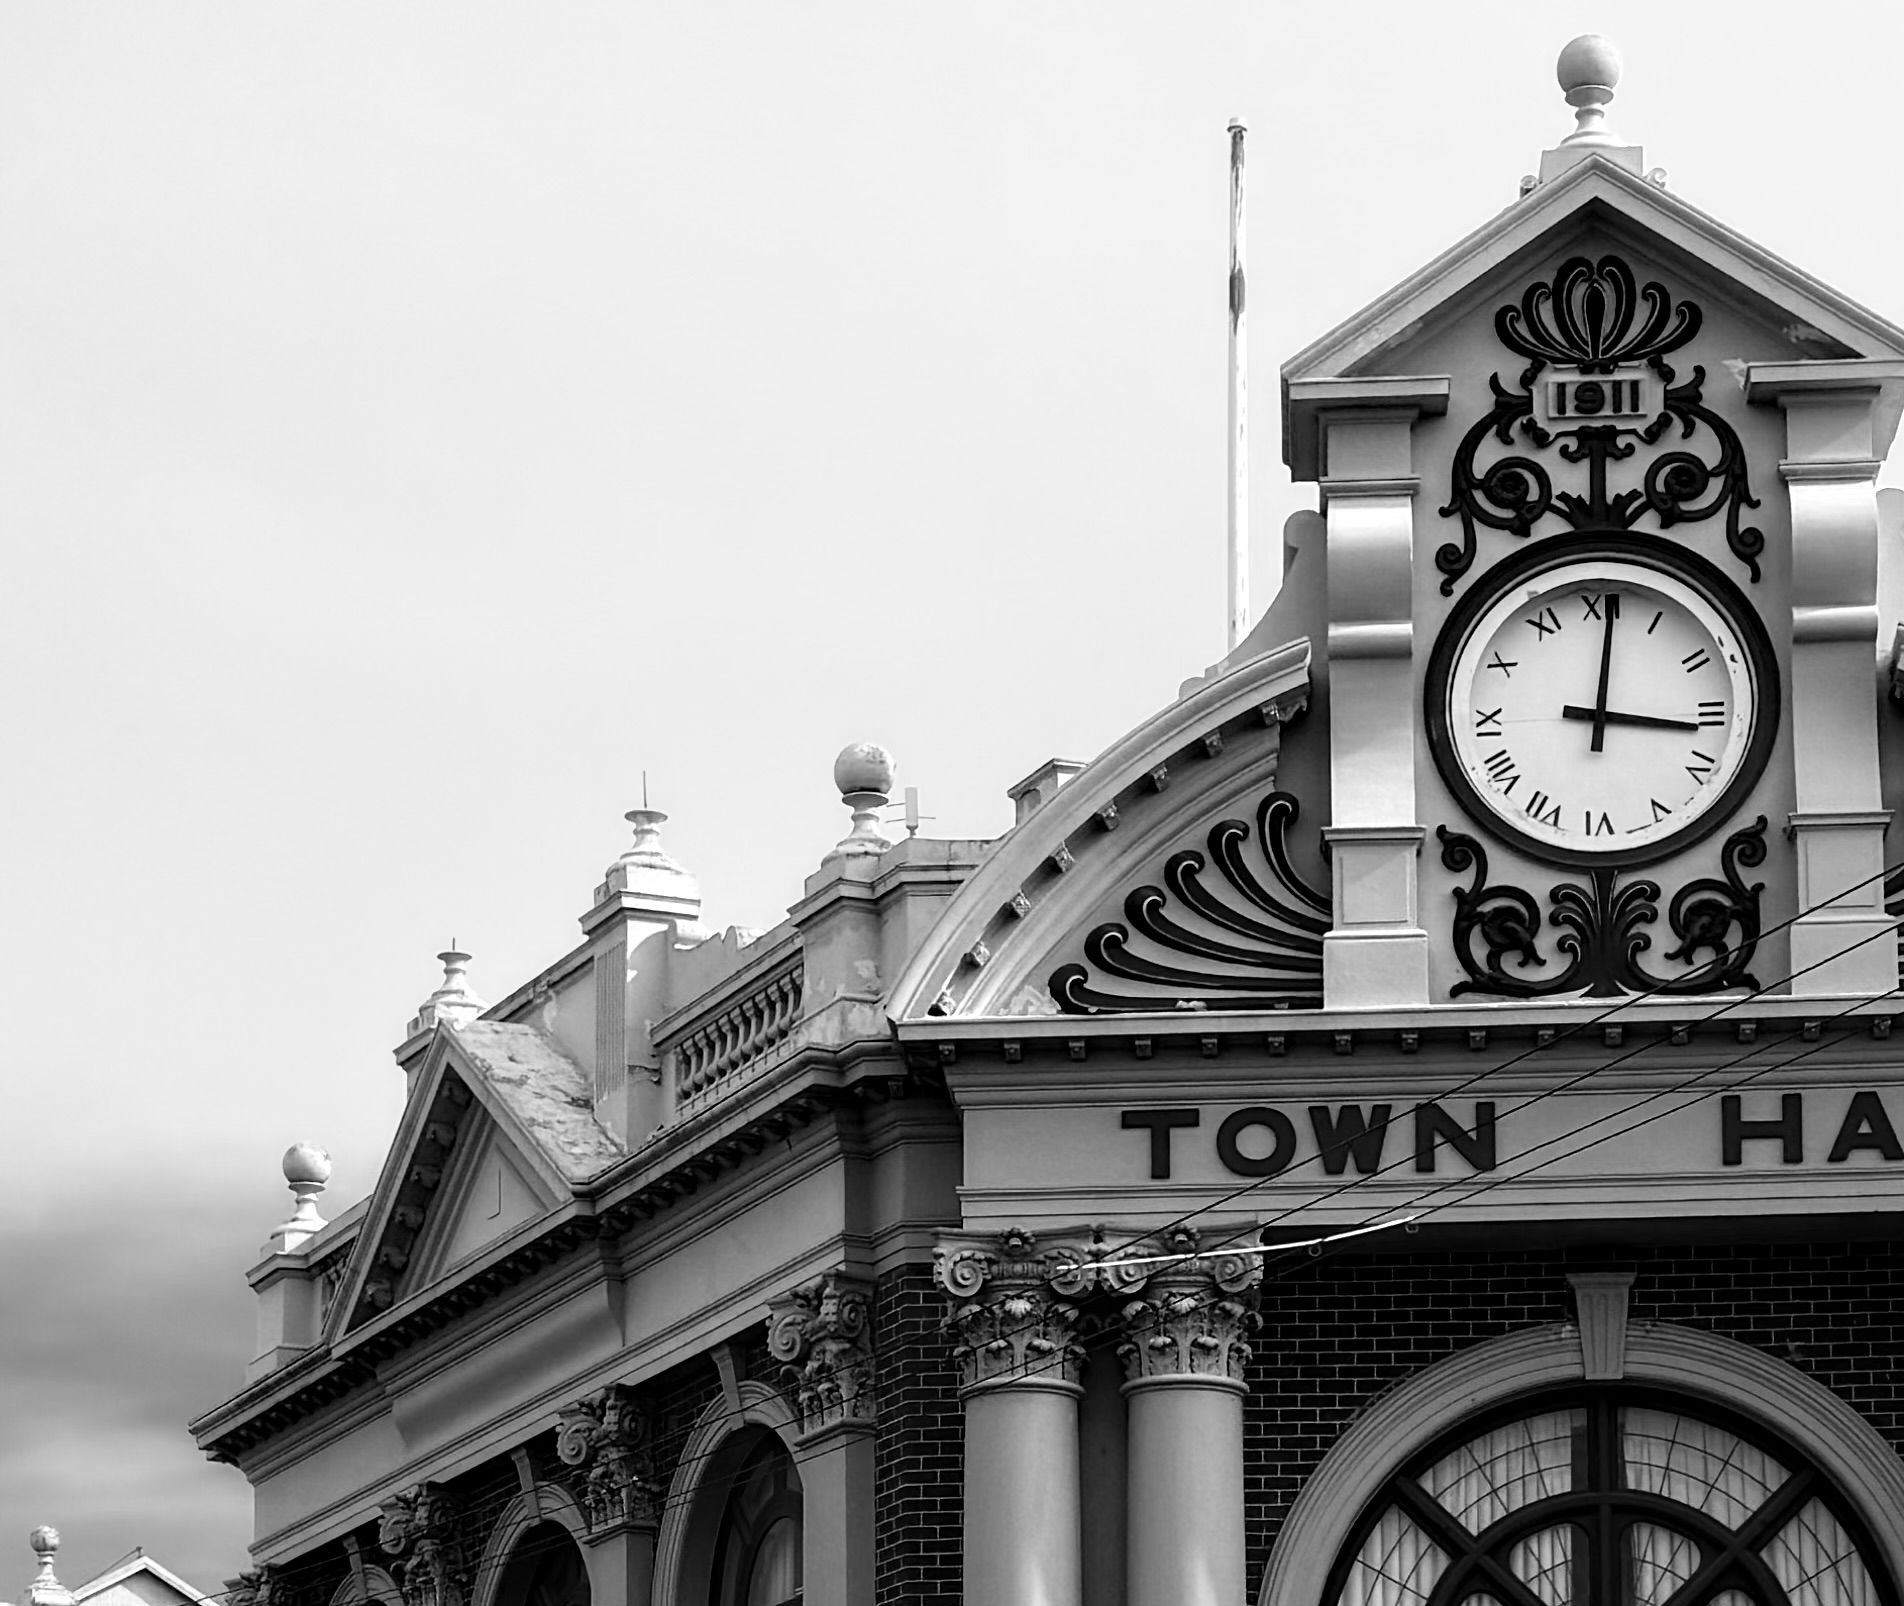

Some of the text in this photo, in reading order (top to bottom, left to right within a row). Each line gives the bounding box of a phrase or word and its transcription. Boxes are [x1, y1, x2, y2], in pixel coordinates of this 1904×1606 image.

[1557, 381, 1639, 415] 1911
[1581, 594, 1619, 620] XI
[1525, 607, 1561, 641] XI
[1647, 611, 1663, 634] I
[1486, 651, 1518, 678] X
[1682, 648, 1710, 673] II
[1475, 708, 1502, 737] IX
[1698, 701, 1725, 726] III
[1585, 810, 1615, 836] VI
[1121, 1101, 1497, 1180] TOWN
